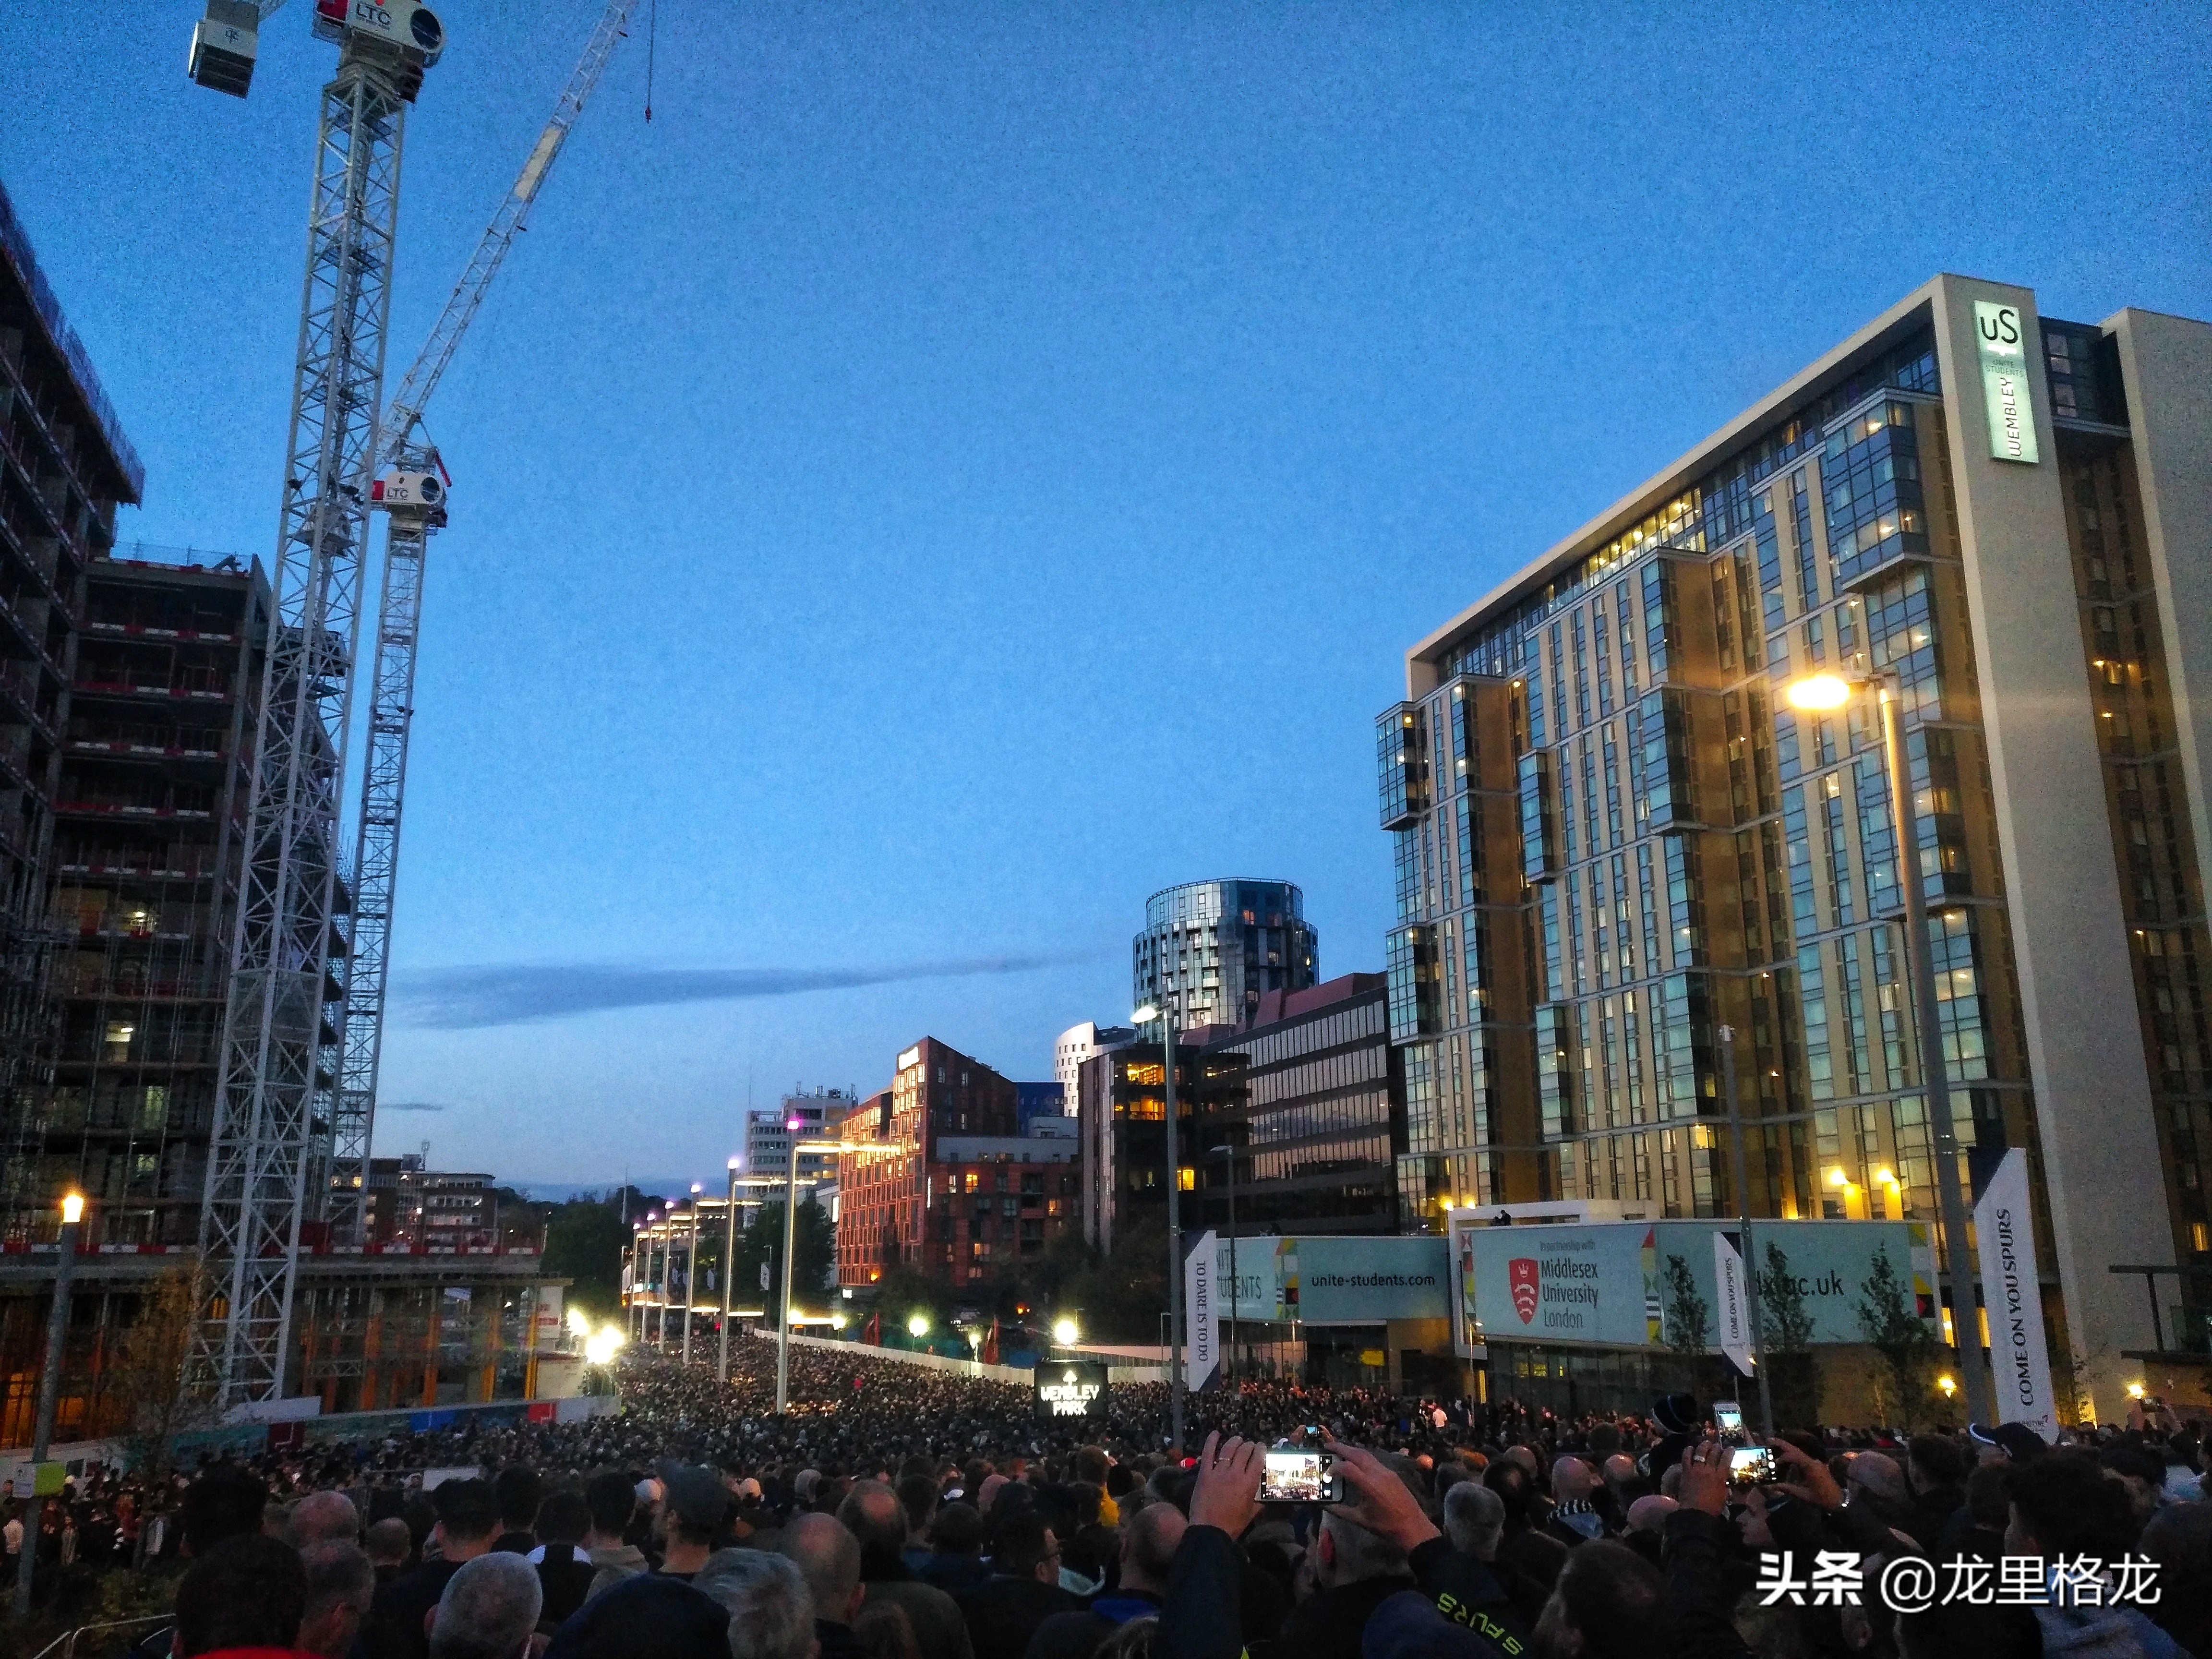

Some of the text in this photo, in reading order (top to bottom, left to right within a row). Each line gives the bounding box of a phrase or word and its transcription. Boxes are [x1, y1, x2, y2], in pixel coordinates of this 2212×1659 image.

[356, 3, 392, 25] LTC
[1986, 365, 2024, 377] STUDENTS
[1999, 377, 2021, 457] WEMBLEY
[387, 488, 408, 499] LTC
[1547, 1239, 1580, 1253] partnership
[1581, 1238, 1595, 1250] with
[1541, 1258, 1598, 1278] Middlesex
[1725, 1258, 1734, 1285] SPURS
[1312, 1272, 1435, 1286] unite-students.com
[1542, 1283, 1598, 1309] University
[1727, 1285, 1735, 1301] YOU
[1196, 1261, 1208, 1362] TO DARE IS TO DO
[1544, 1307, 1583, 1328] London
[1730, 1302, 1736, 1314] ON
[1997, 1209, 2033, 1406] COME ON YOU SPURS
[1730, 1315, 1738, 1339] COME
[1041, 1385, 1099, 1401] WEMBLEY
[1053, 1400, 1087, 1417] PARK
